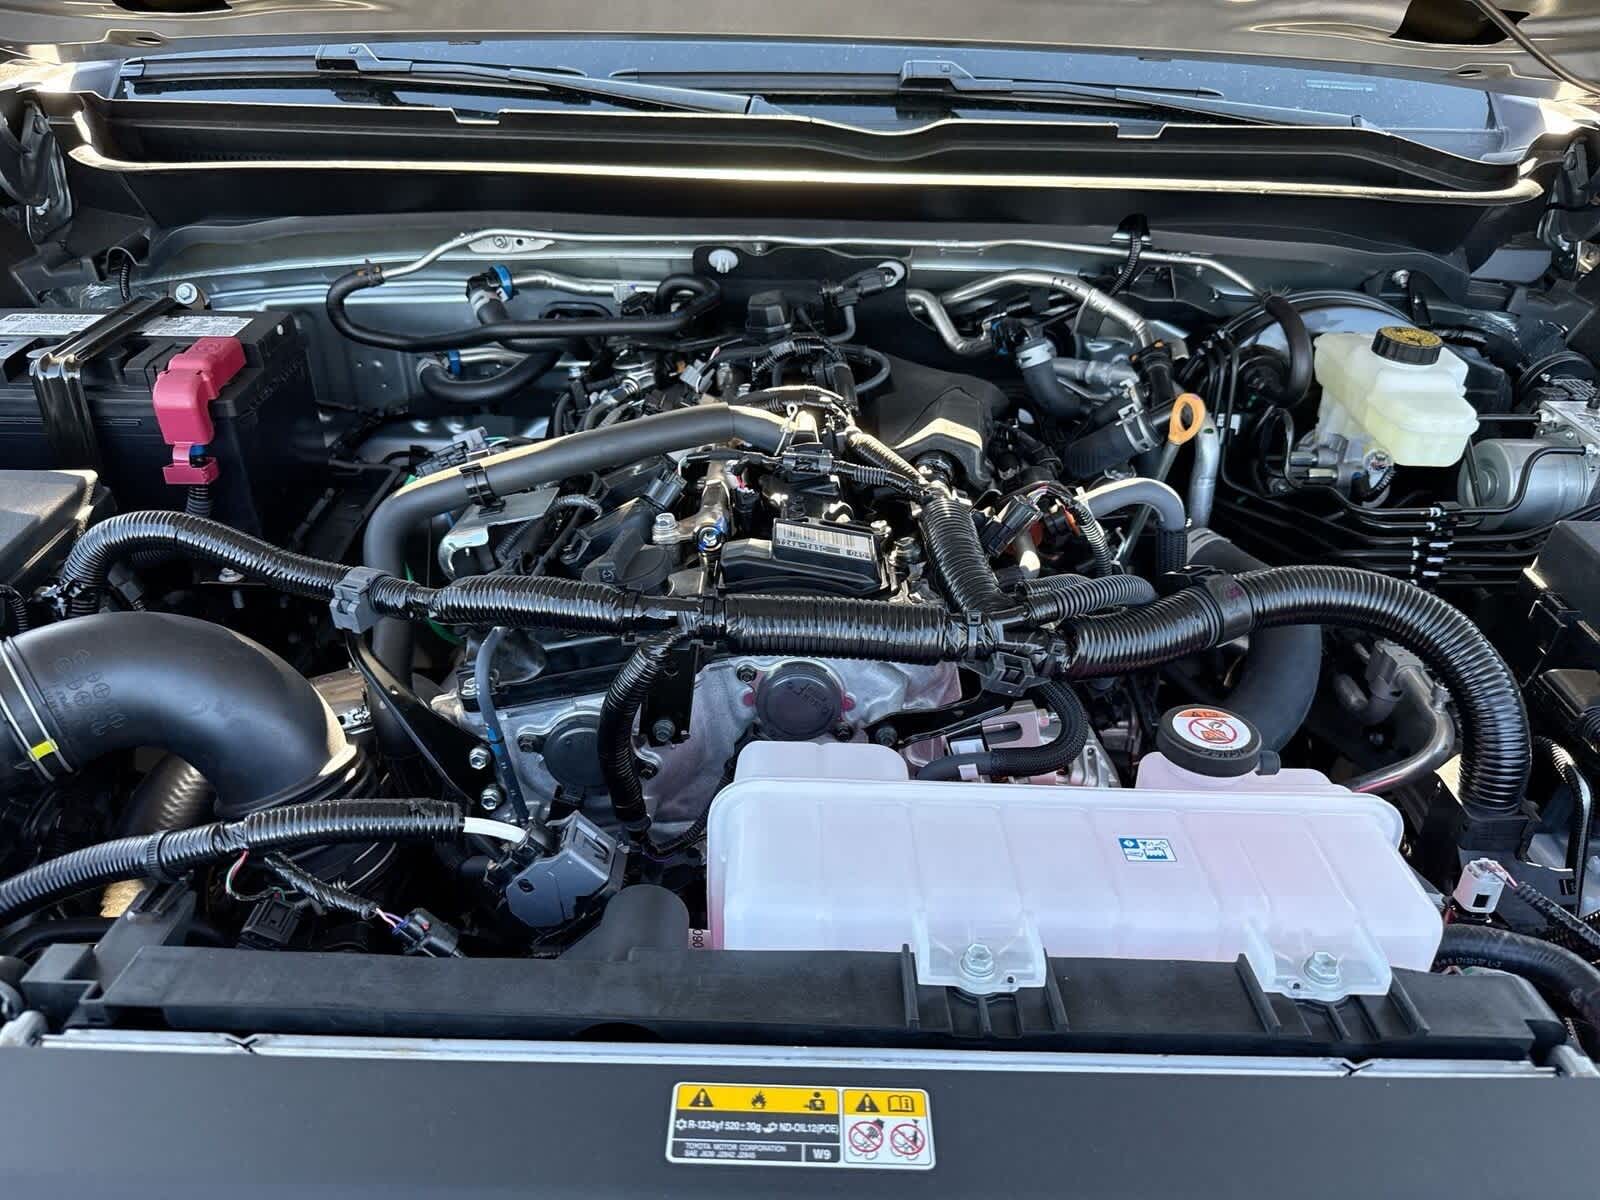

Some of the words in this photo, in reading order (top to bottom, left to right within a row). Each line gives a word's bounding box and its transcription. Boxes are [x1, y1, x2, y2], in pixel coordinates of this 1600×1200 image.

[685, 1142, 712, 1150] TOYOTA
[739, 1144, 787, 1152] CORPORATION
[812, 1149, 831, 1159] W9
